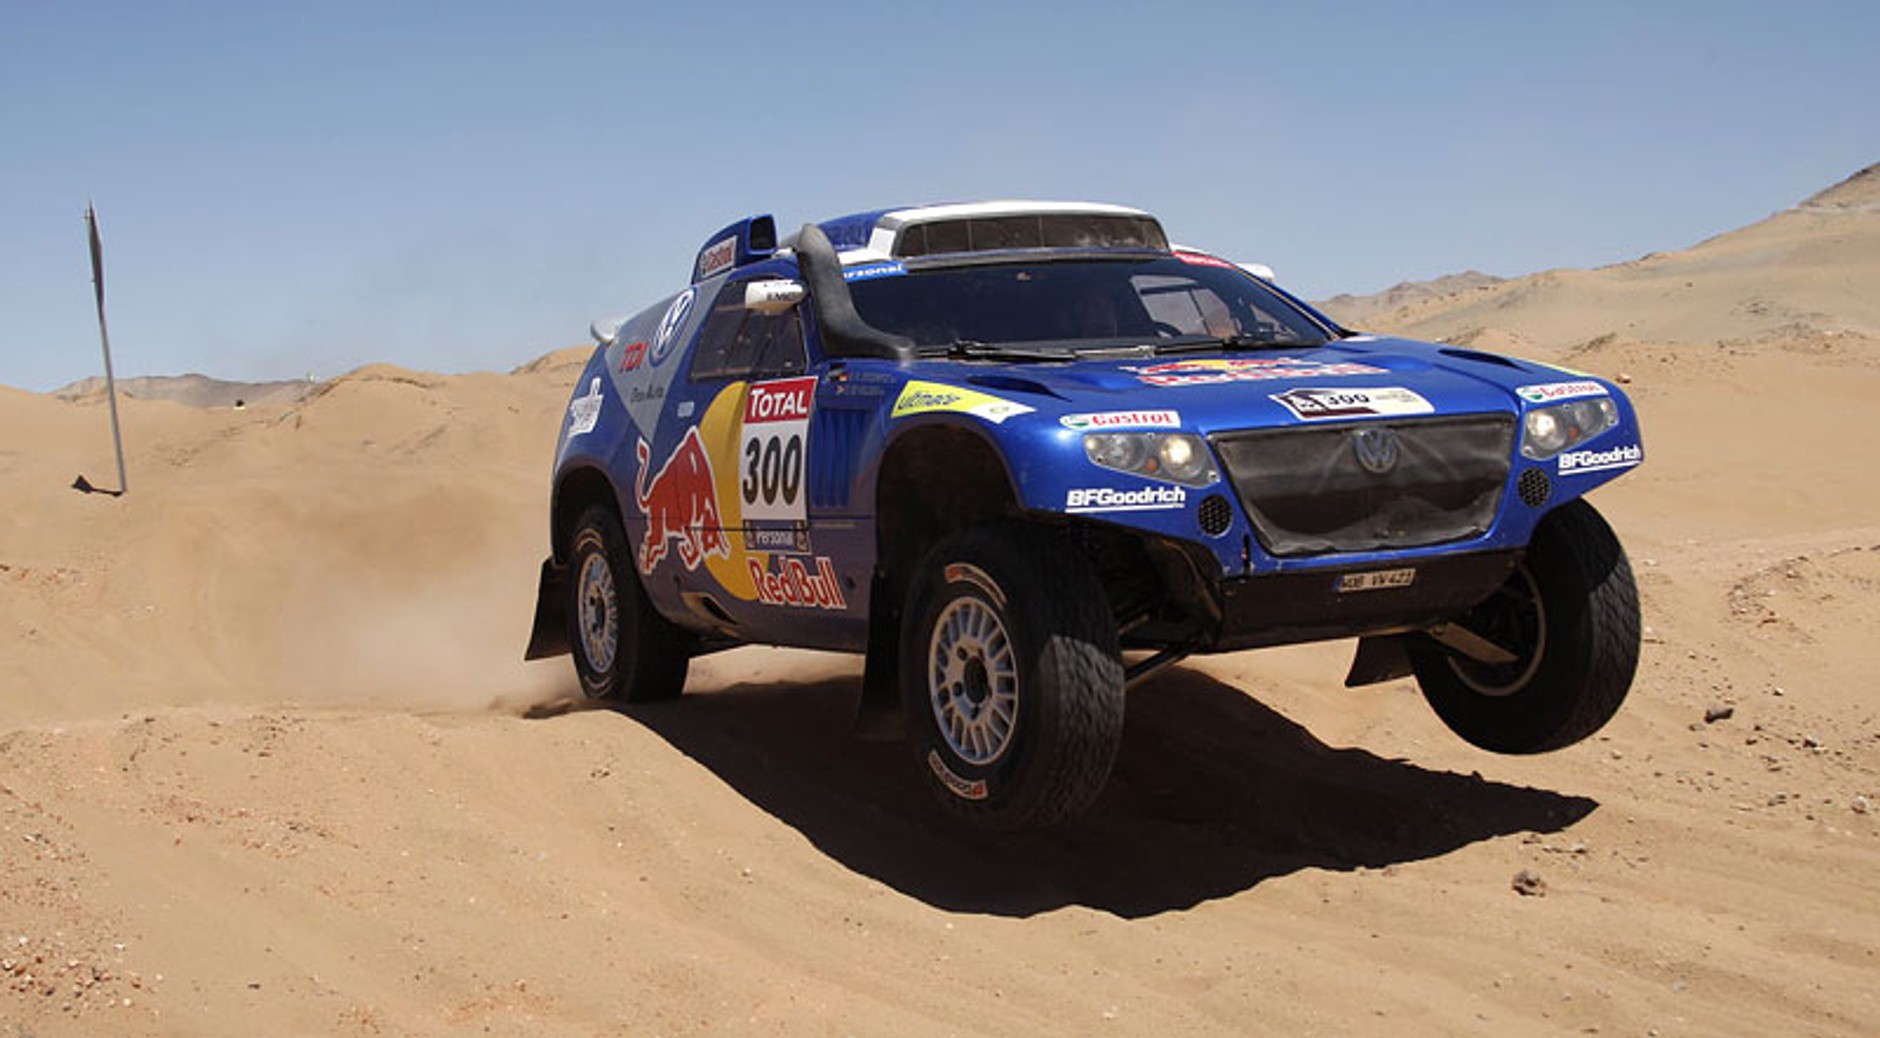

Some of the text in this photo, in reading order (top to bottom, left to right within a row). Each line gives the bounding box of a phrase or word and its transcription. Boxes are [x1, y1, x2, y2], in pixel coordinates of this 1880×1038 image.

[619, 340, 650, 374] TDI
[1091, 413, 1175, 427] Castrol
[1558, 444, 1641, 469] BFGoodrich
[742, 434, 803, 506] 300
[1066, 485, 1187, 507] BFGoodrich
